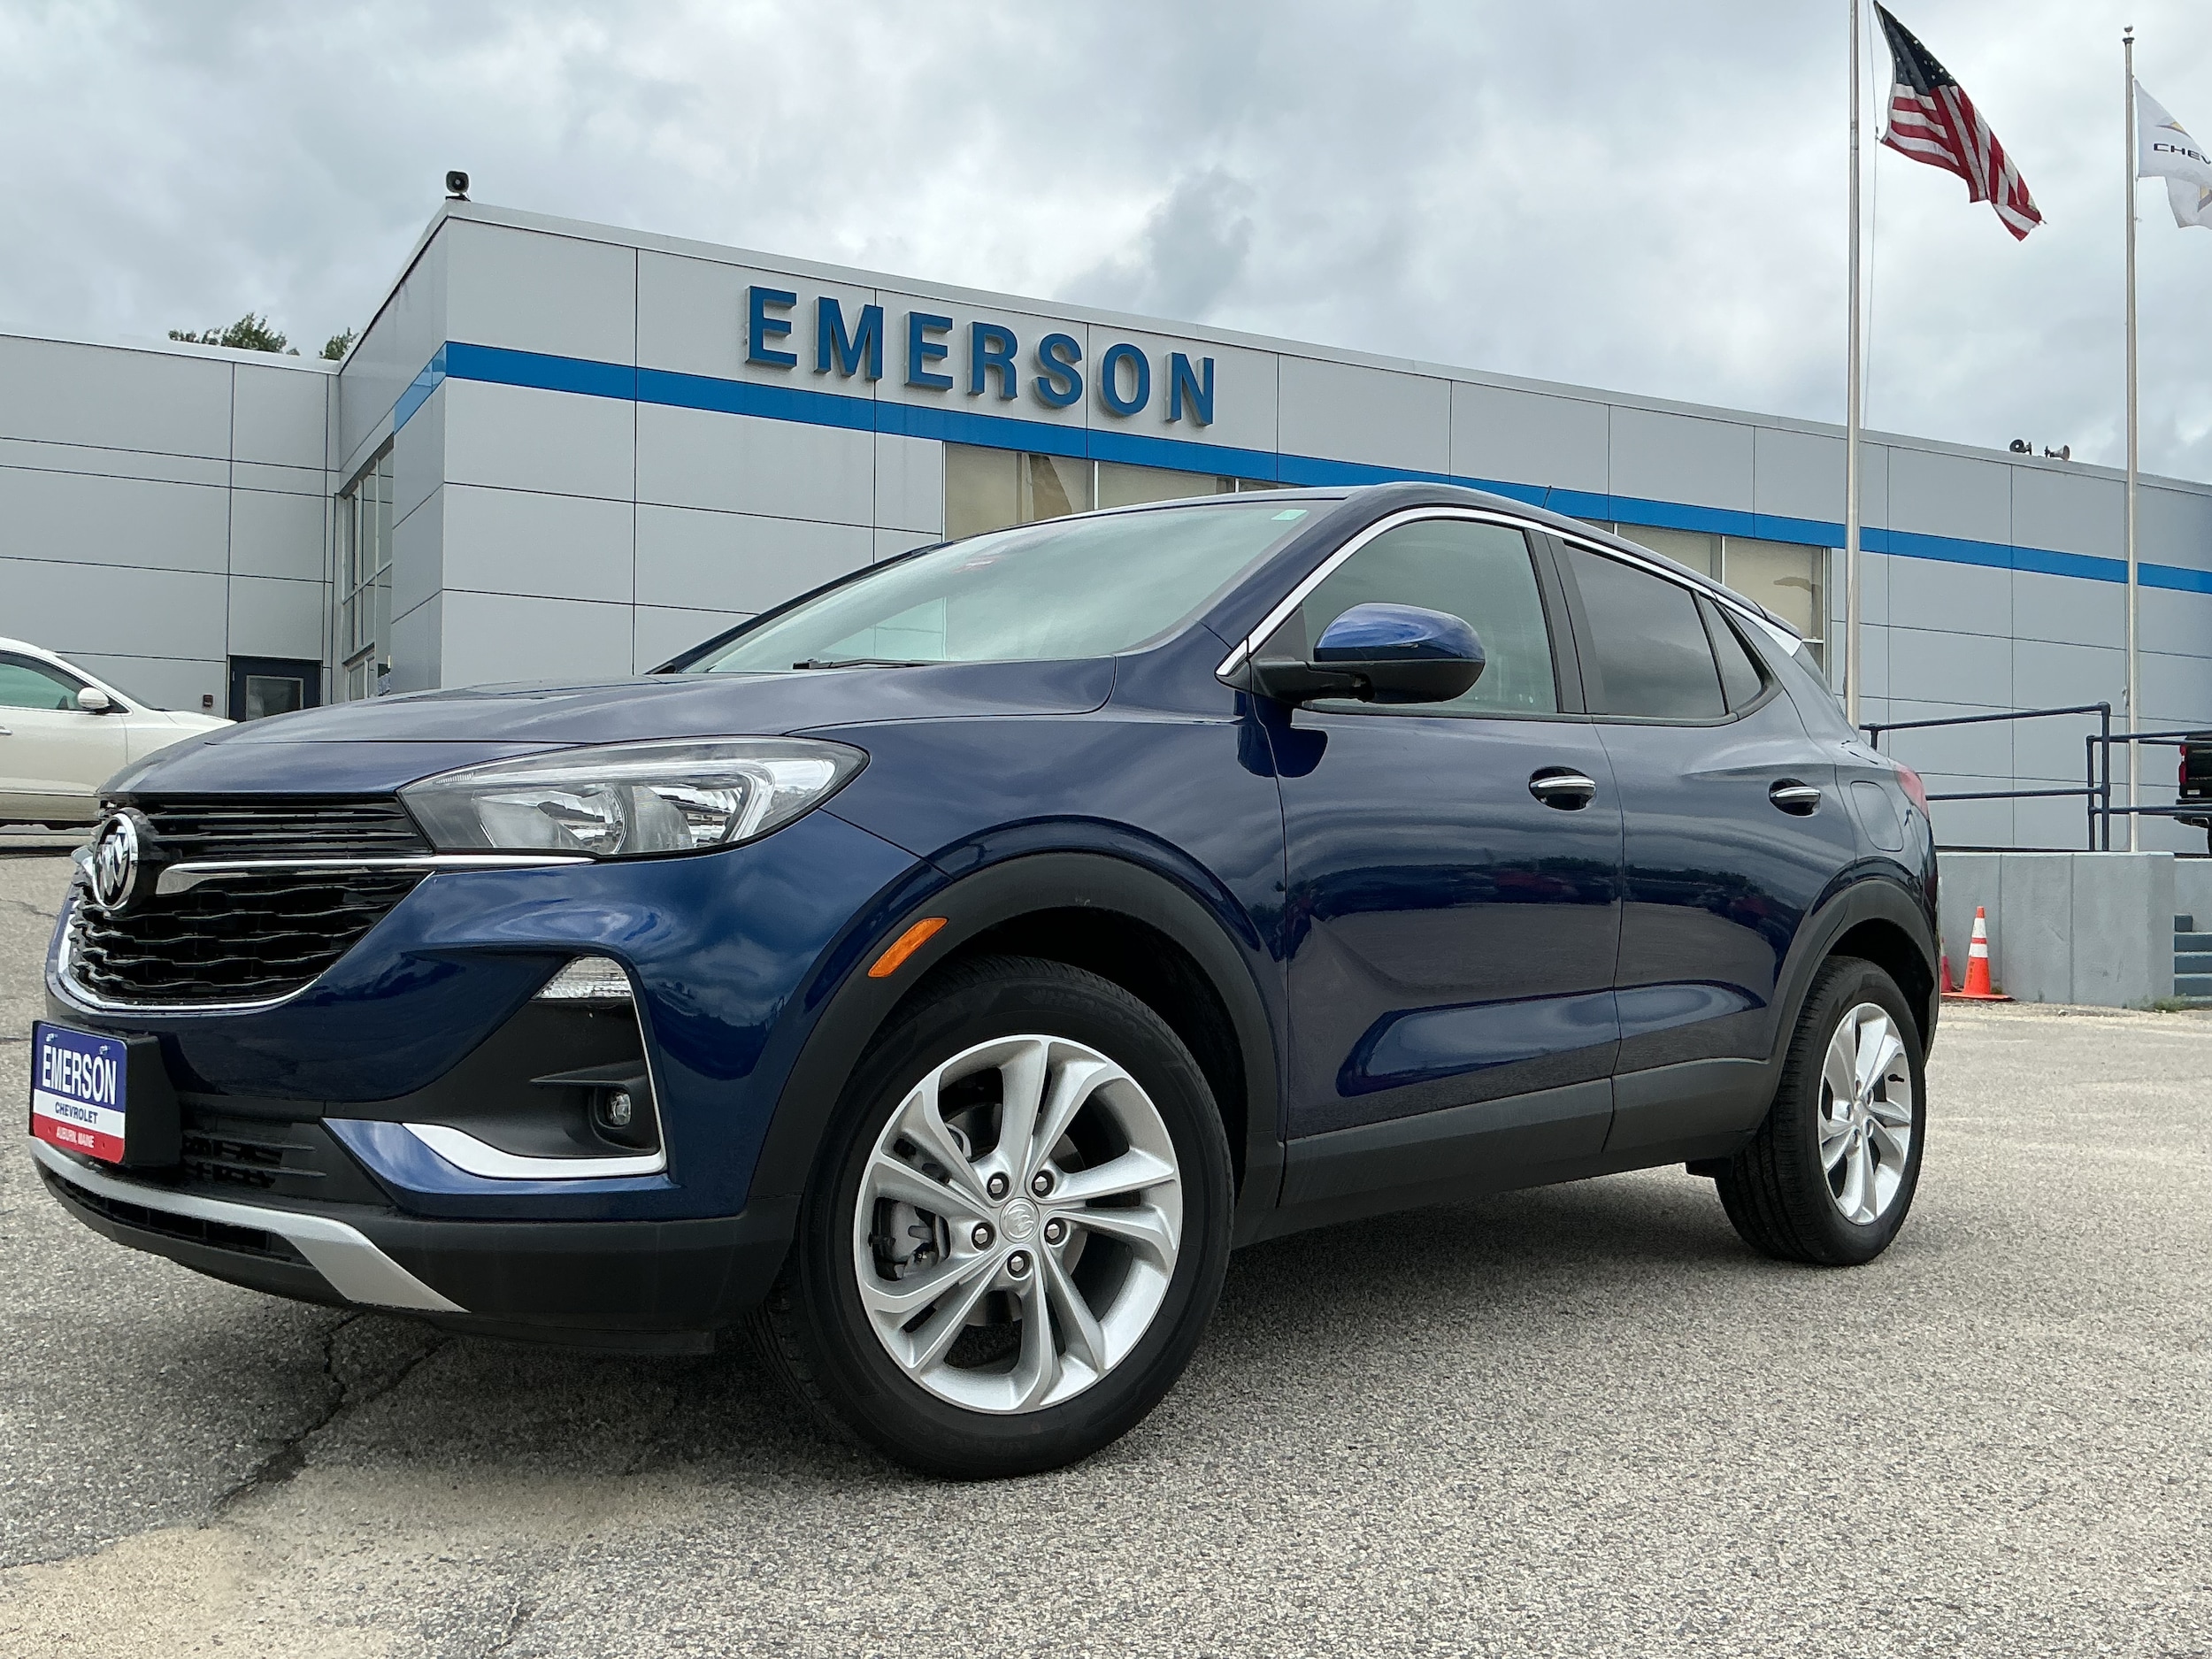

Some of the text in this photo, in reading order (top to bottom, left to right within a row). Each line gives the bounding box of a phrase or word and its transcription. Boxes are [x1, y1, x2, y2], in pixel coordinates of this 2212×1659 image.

[745, 286, 1215, 426] EMERSON
[42, 1045, 116, 1104] EMERSON
[55, 1102, 98, 1124] CHEVROLET
